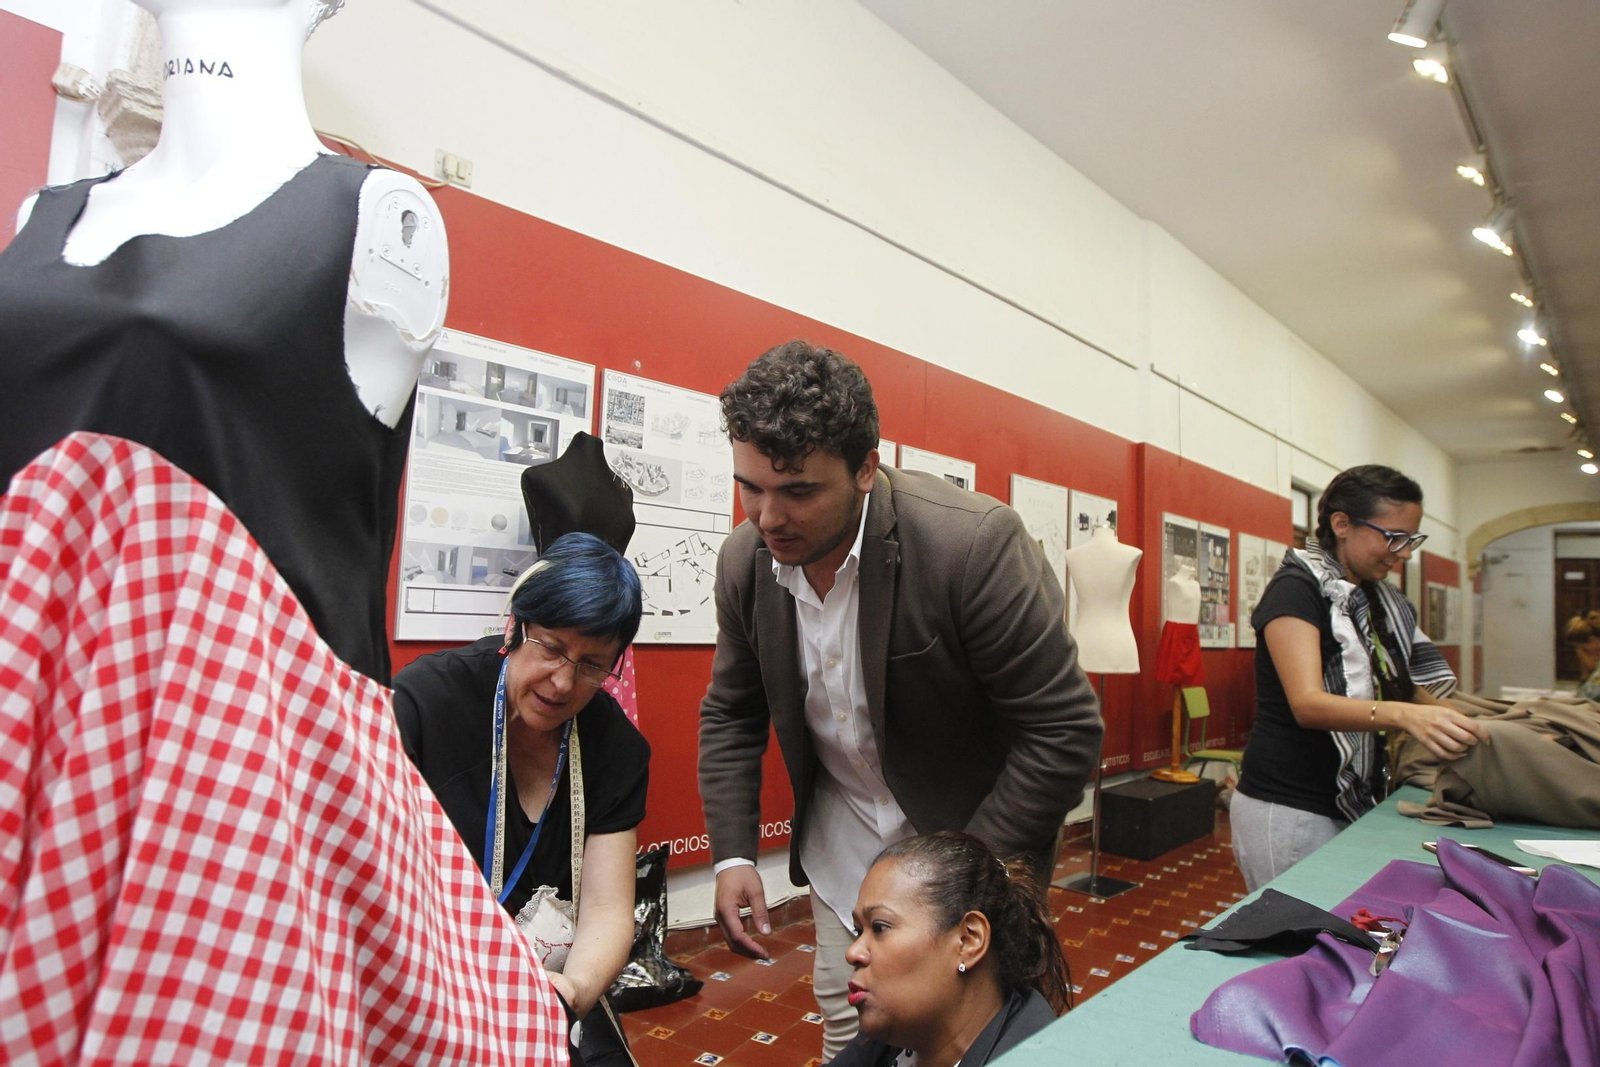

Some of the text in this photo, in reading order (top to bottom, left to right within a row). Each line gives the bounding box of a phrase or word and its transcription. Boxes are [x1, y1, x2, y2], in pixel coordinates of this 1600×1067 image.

[1144, 750, 1164, 762] ESCUELA
[647, 834, 710, 856] OICIOS
[759, 820, 792, 839] ICOS
